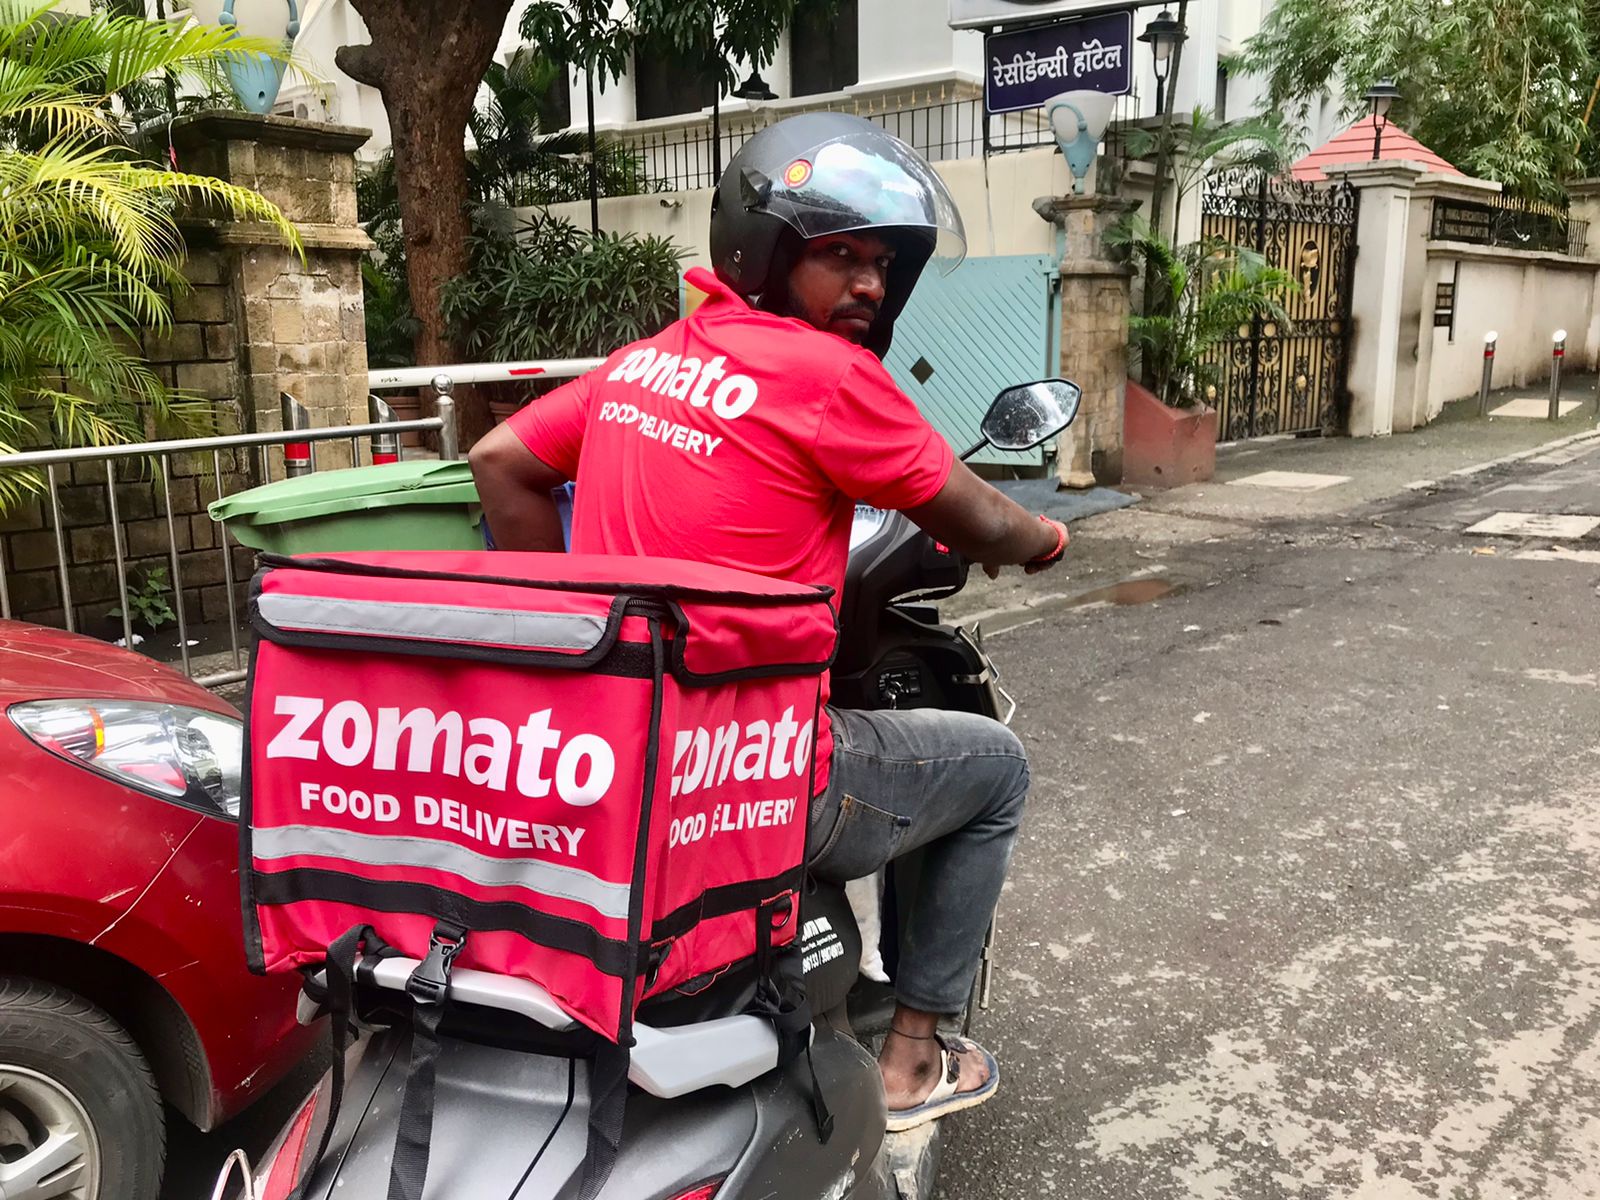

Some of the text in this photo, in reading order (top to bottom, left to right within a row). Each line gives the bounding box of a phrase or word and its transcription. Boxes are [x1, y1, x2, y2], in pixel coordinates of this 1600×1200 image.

[1073, 38, 1122, 78] हॉटेल
[607, 347, 759, 420] zomato
[599, 401, 640, 425] FOOD
[266, 694, 616, 807] zomato
[300, 781, 586, 857] FOOD DELIVERY
[669, 812, 707, 849] OOD
